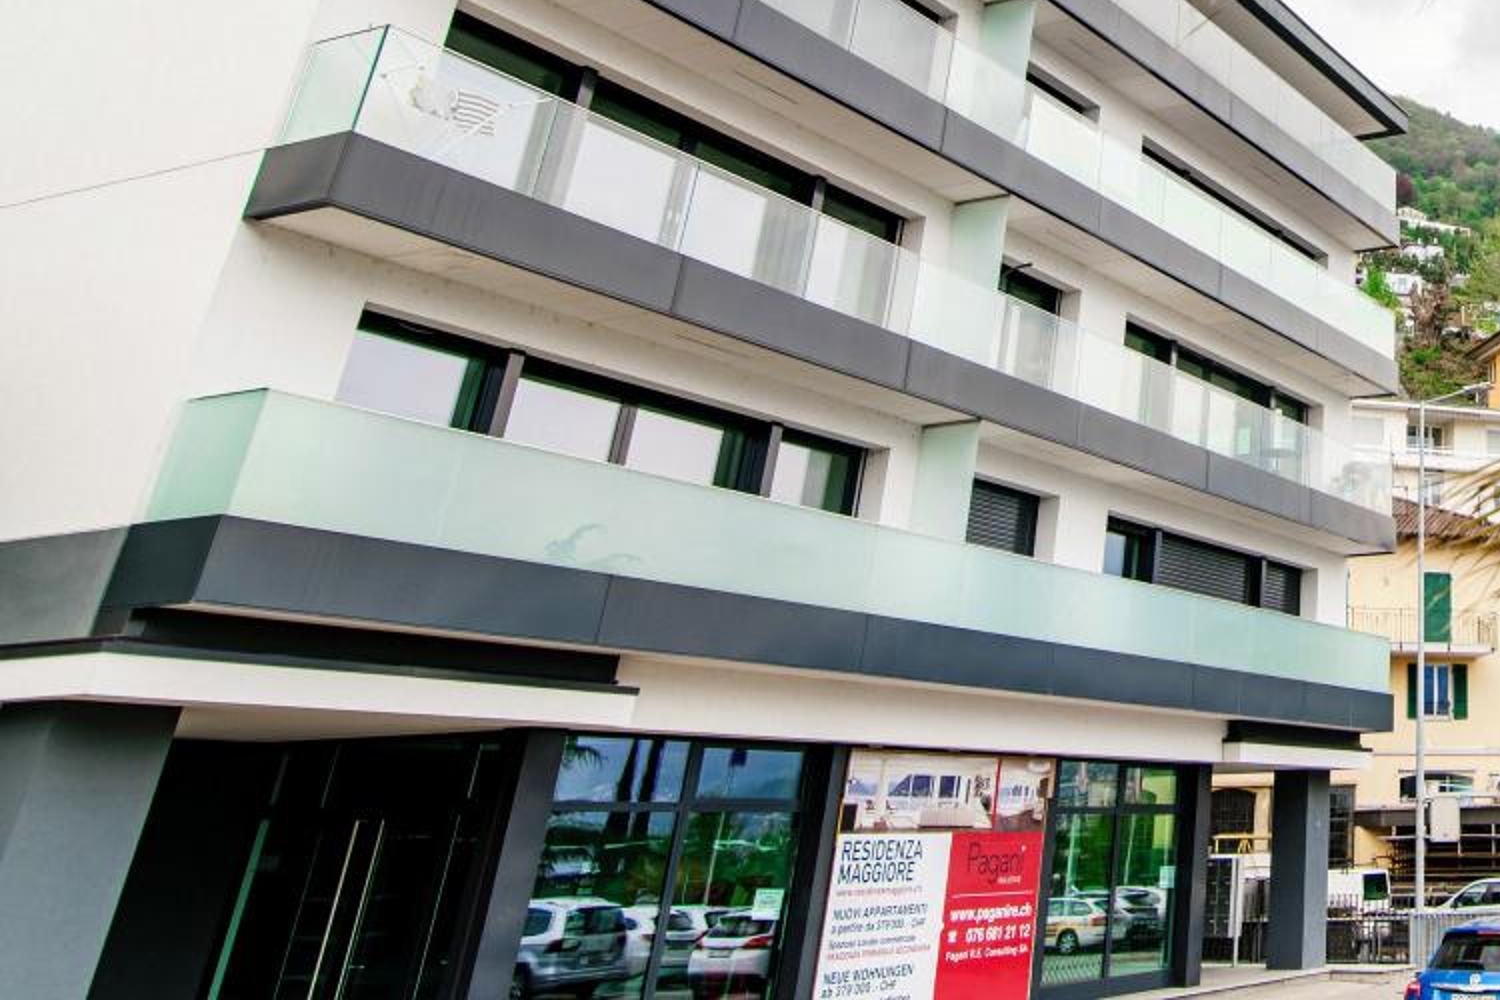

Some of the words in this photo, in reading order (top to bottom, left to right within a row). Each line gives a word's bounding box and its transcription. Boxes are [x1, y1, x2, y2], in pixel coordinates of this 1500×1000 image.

[841, 839, 923, 862] RESIDENZA
[837, 861, 915, 885] MAGGIORE
[966, 841, 1027, 884] Pagani
[1020, 923, 1031, 937] 12
[823, 970, 850, 984] NEUE
